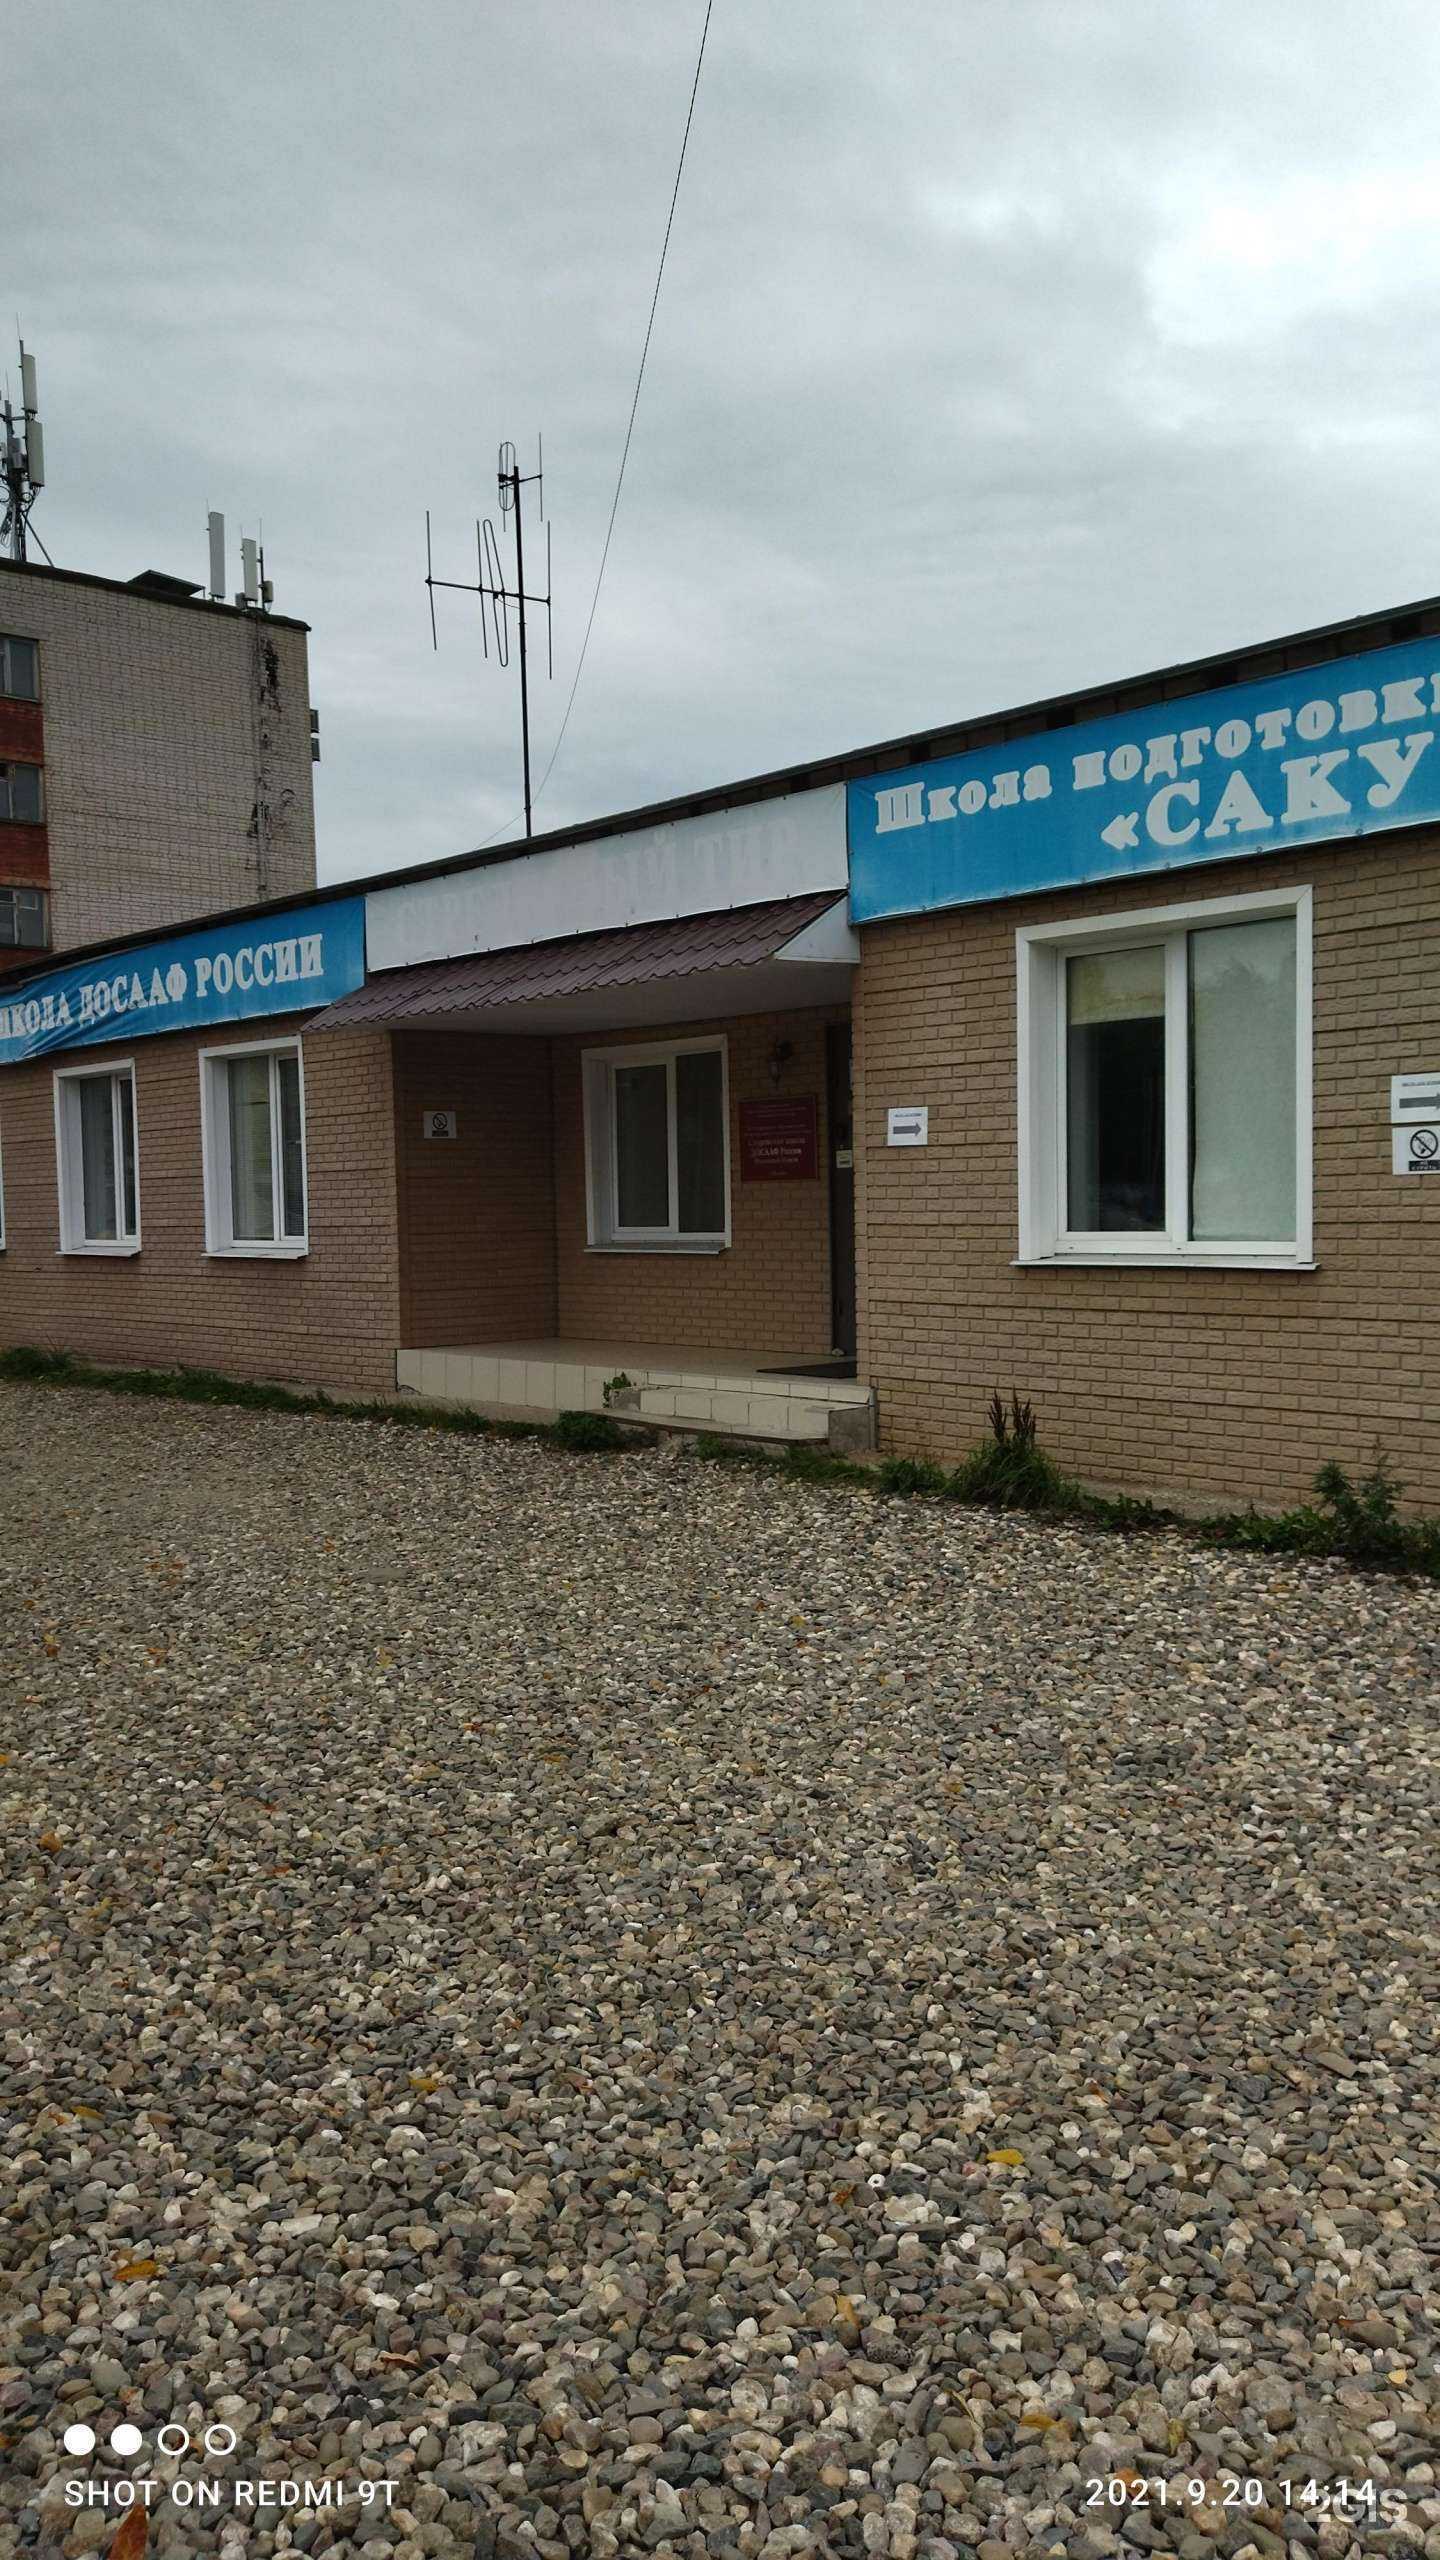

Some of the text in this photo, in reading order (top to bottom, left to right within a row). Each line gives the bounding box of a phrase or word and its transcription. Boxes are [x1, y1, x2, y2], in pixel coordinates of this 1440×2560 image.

[876, 672, 1440, 833] Школа подготовк
[78, 963, 188, 1025] ДОСААФ
[194, 933, 324, 998] РОССИИ
